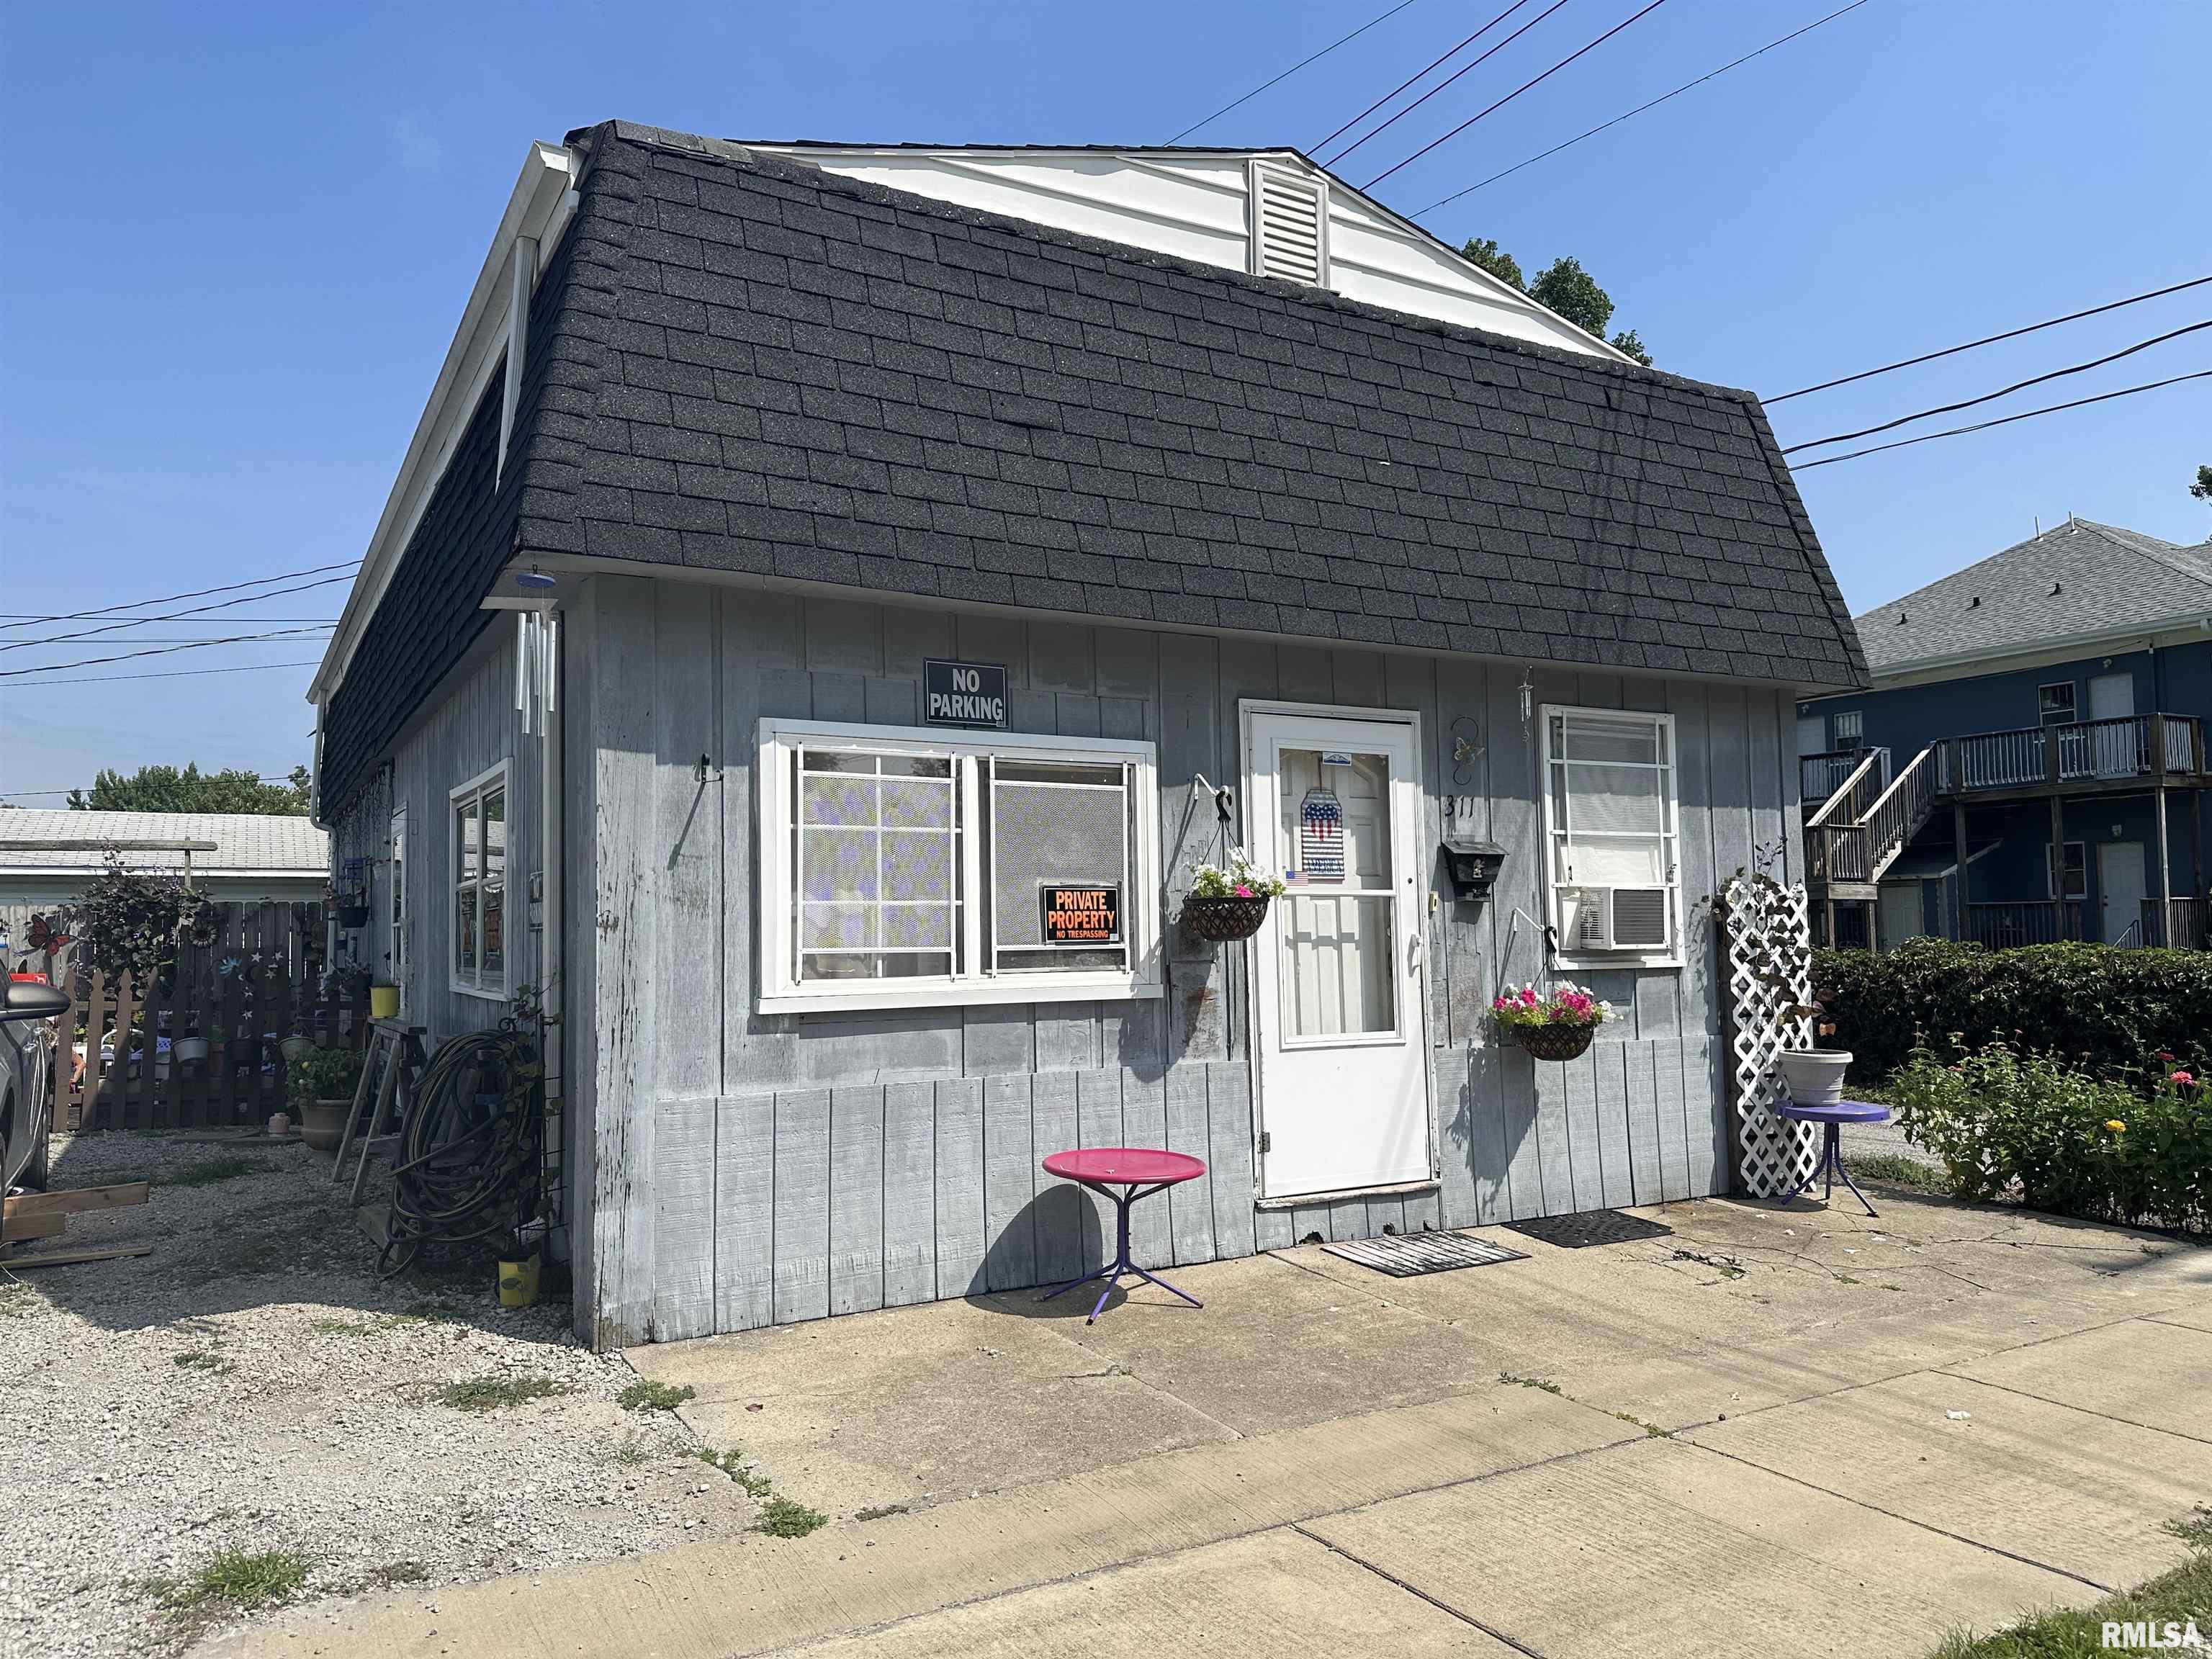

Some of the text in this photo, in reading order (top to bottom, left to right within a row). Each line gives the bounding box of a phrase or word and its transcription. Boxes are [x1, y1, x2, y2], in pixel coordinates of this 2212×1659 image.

[953, 668, 980, 693] NO
[930, 693, 1003, 721] PARKING
[1444, 795, 1475, 819] 311
[1056, 891, 1107, 910] PRIVATE
[1048, 910, 1115, 929] PROPERTY
[1056, 930, 1108, 939] NO TRESPASSING
